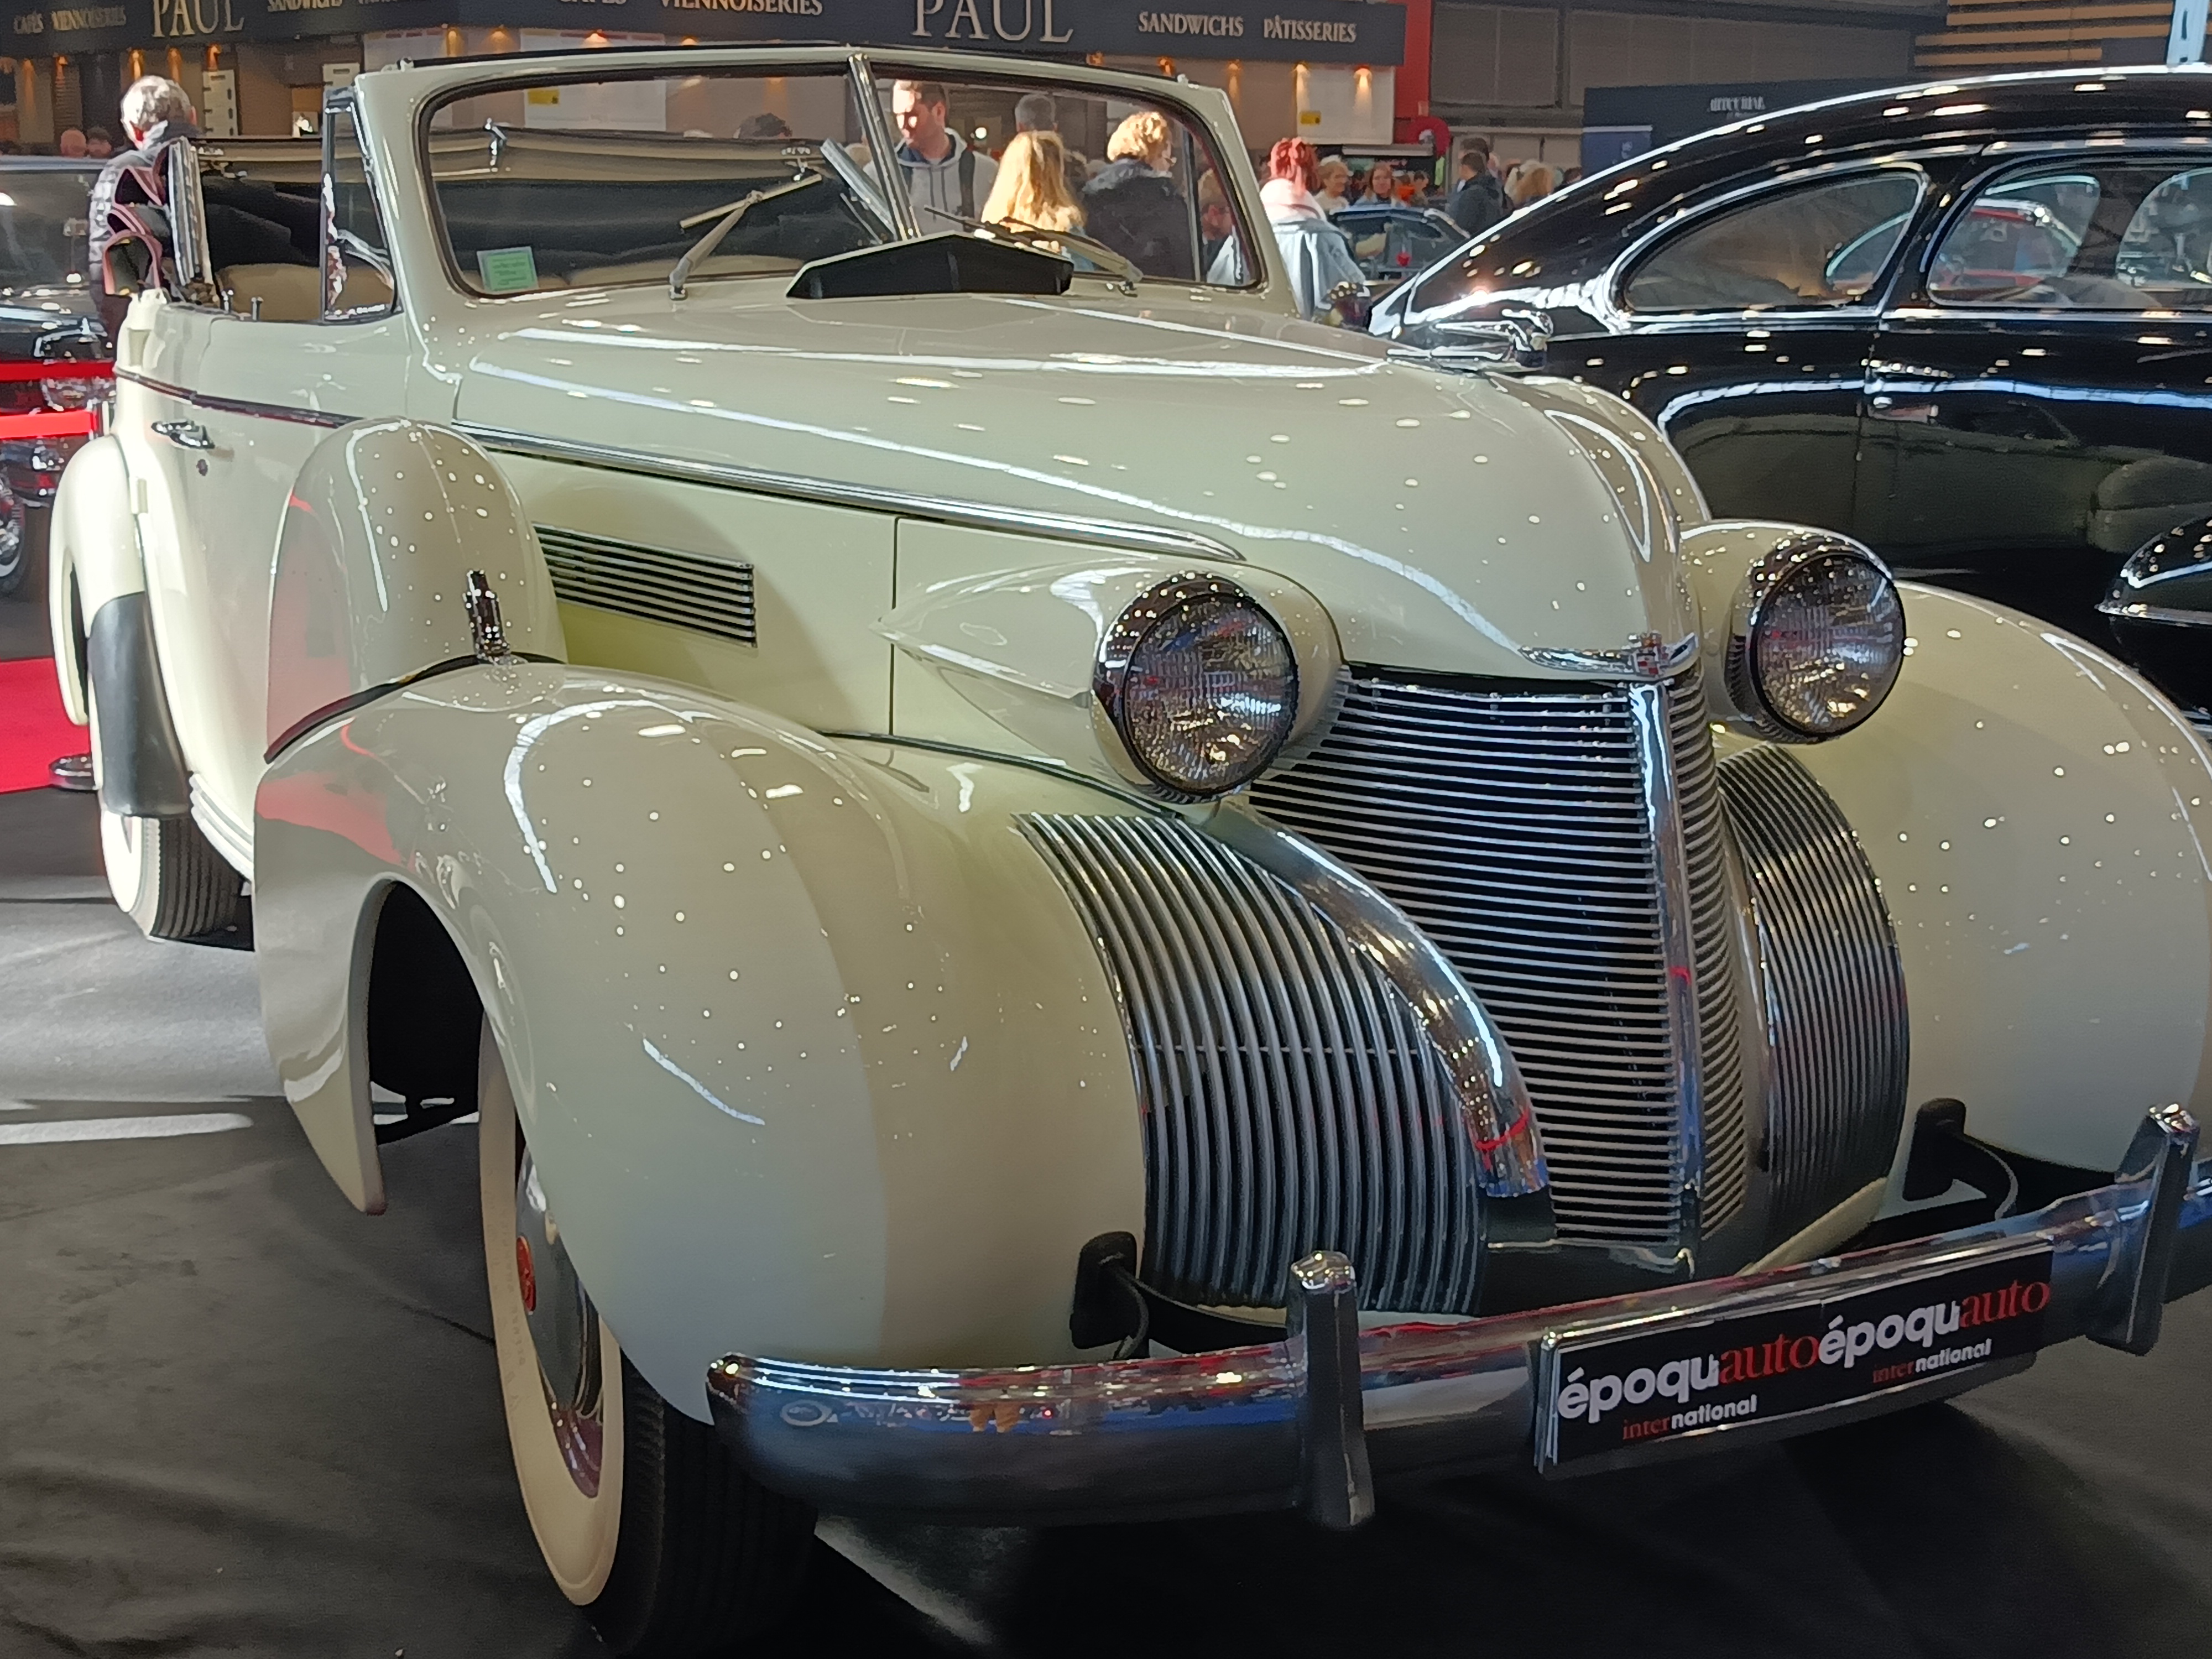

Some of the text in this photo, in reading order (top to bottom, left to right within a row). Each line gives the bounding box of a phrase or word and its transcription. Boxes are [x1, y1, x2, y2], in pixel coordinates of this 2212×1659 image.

[152, 0, 244, 38] PAUL
[910, 0, 1074, 43] PAUL
[1138, 11, 1358, 43] SANDWICHS PÂTISSERIES
[1622, 1393, 1757, 1440] international
